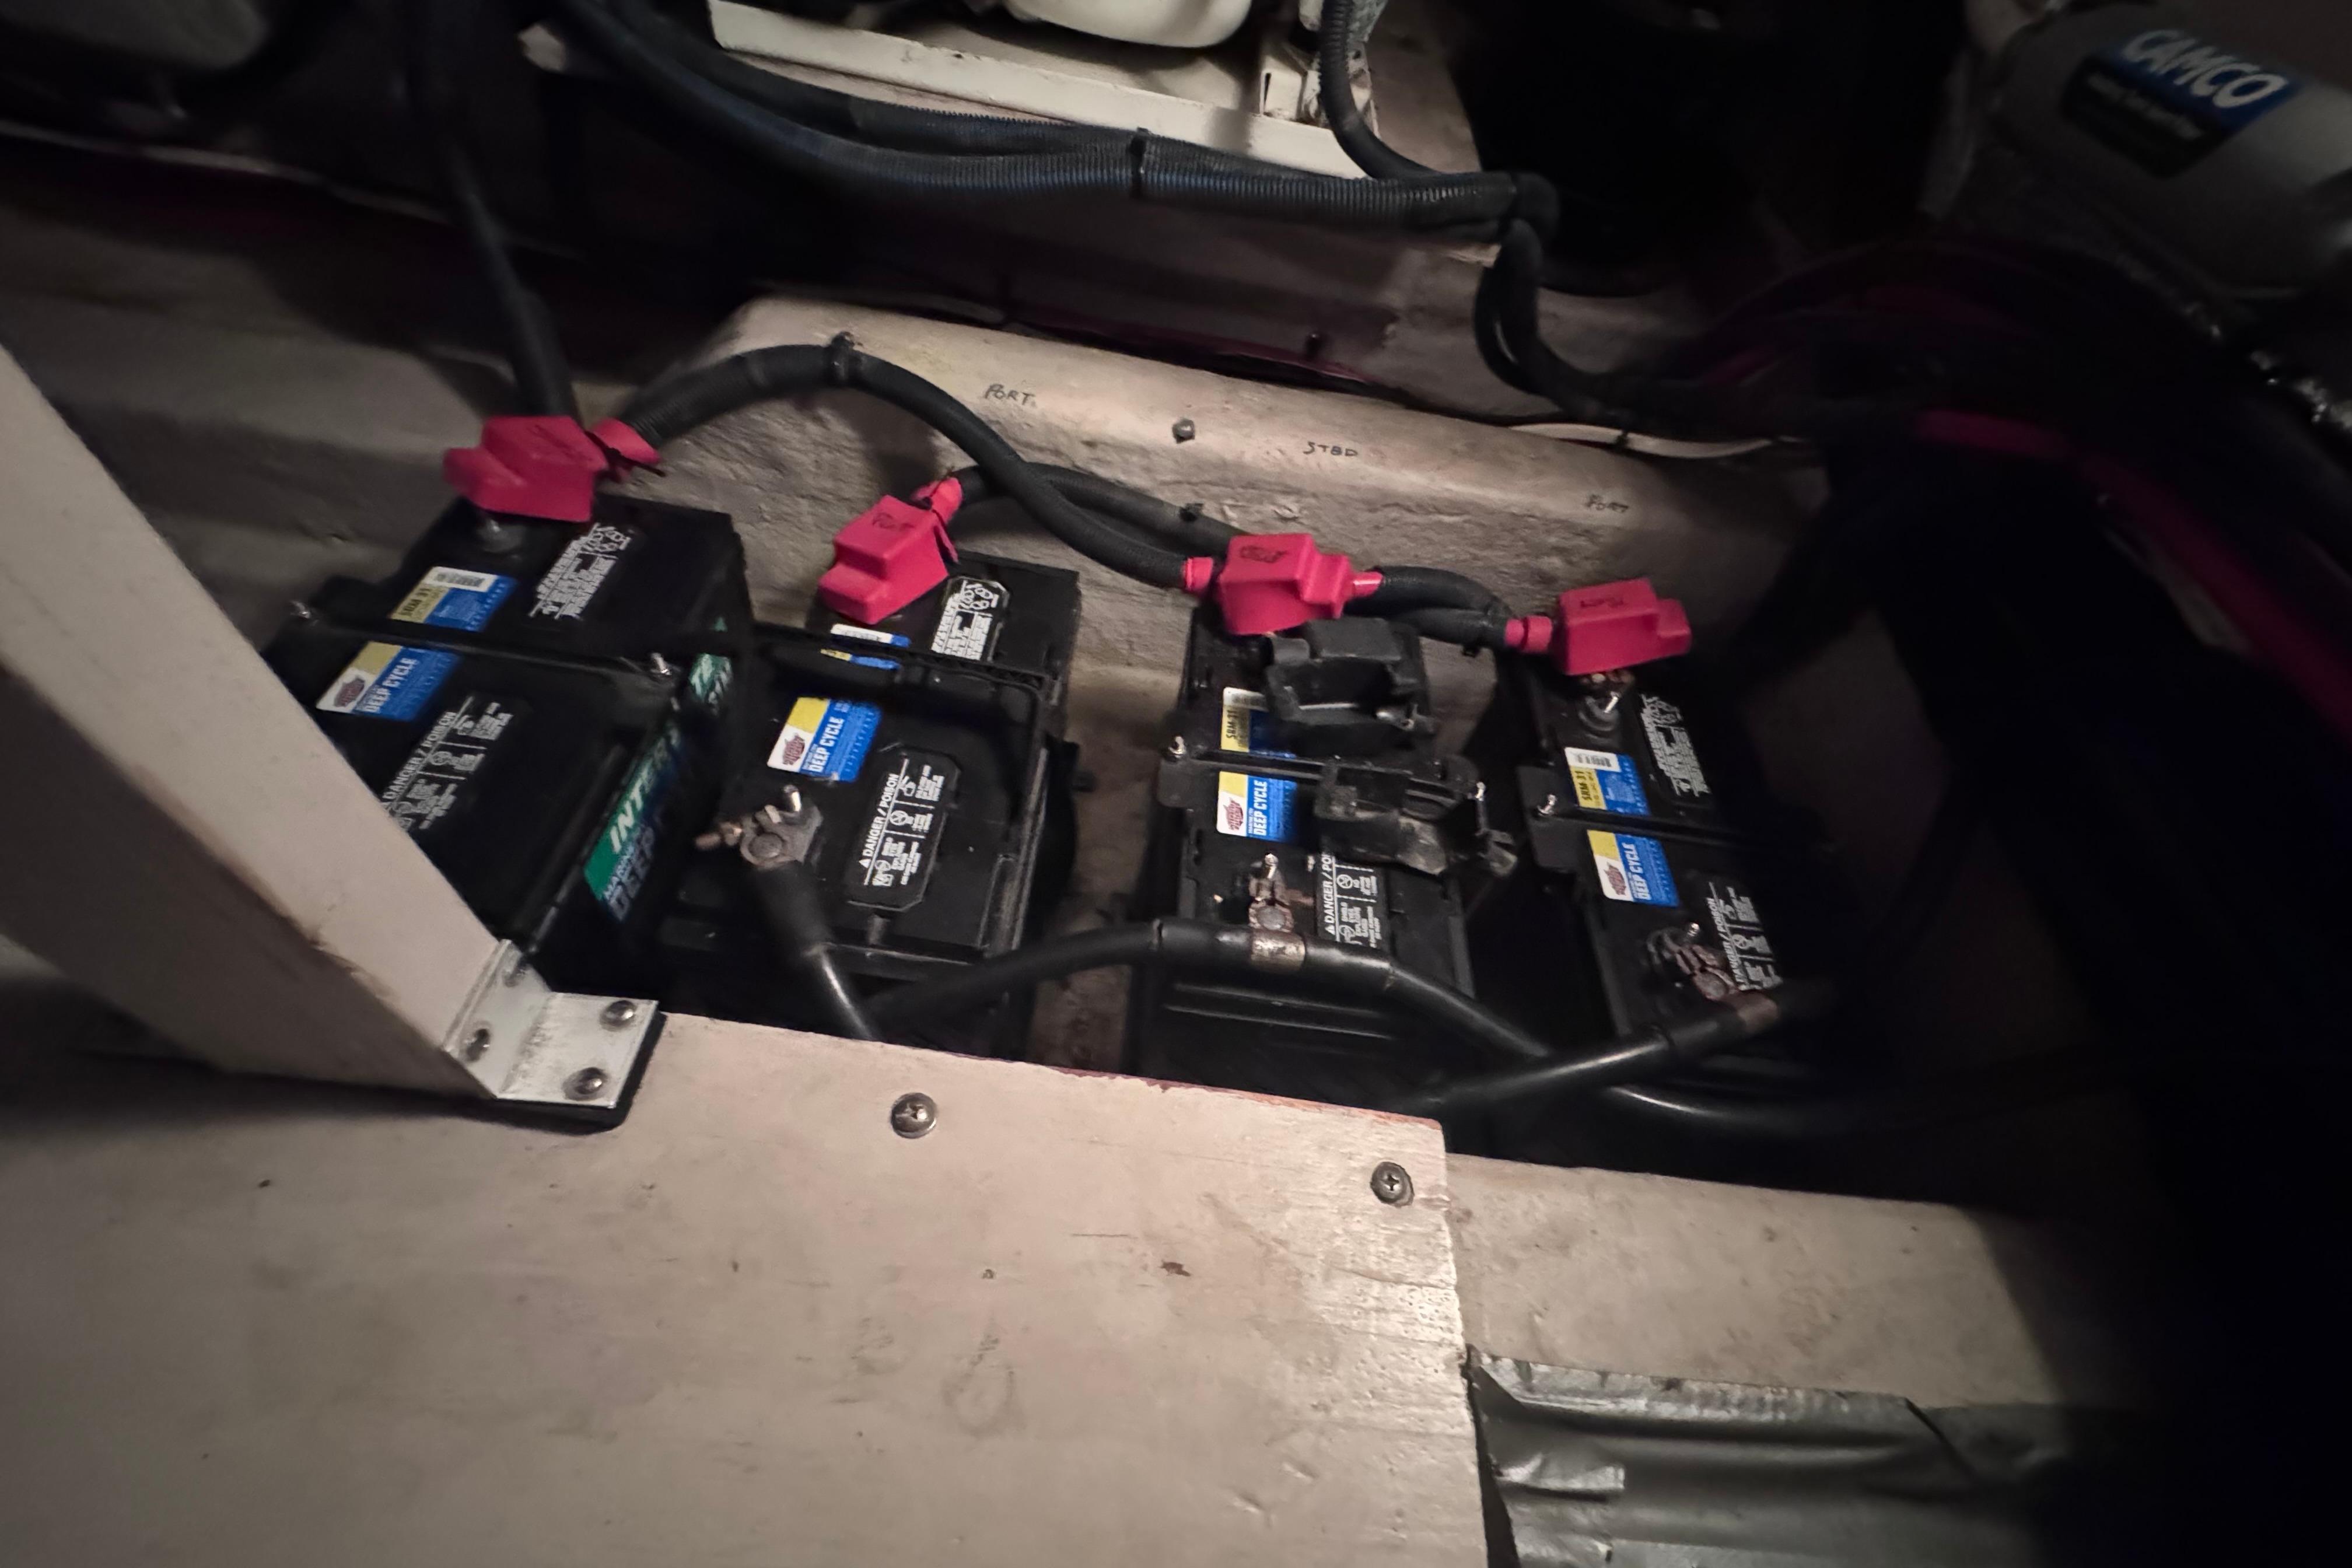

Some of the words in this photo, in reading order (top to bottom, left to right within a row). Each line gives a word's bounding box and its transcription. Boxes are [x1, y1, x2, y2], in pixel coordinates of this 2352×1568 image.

[2122, 29, 2289, 108] CAMCO
[984, 383, 1035, 406] PORT
[1303, 441, 1358, 457] STBD
[364, 687, 391, 714] DEEP
[382, 657, 420, 689] CYCLE
[808, 747, 831, 773] DEEP
[820, 716, 845, 747] CYCLE
[382, 757, 425, 800] DANGER
[1253, 779, 1268, 810] CYCLE
[862, 816, 886, 857] DANGER
[879, 773, 900, 808] POISON
[1253, 811, 1268, 836] DEEP
[1321, 853, 1332, 872] POI
[1621, 842, 1644, 874] CYCLE
[1322, 881, 1335, 924] DANGER
[1633, 874, 1652, 901] DEEP
